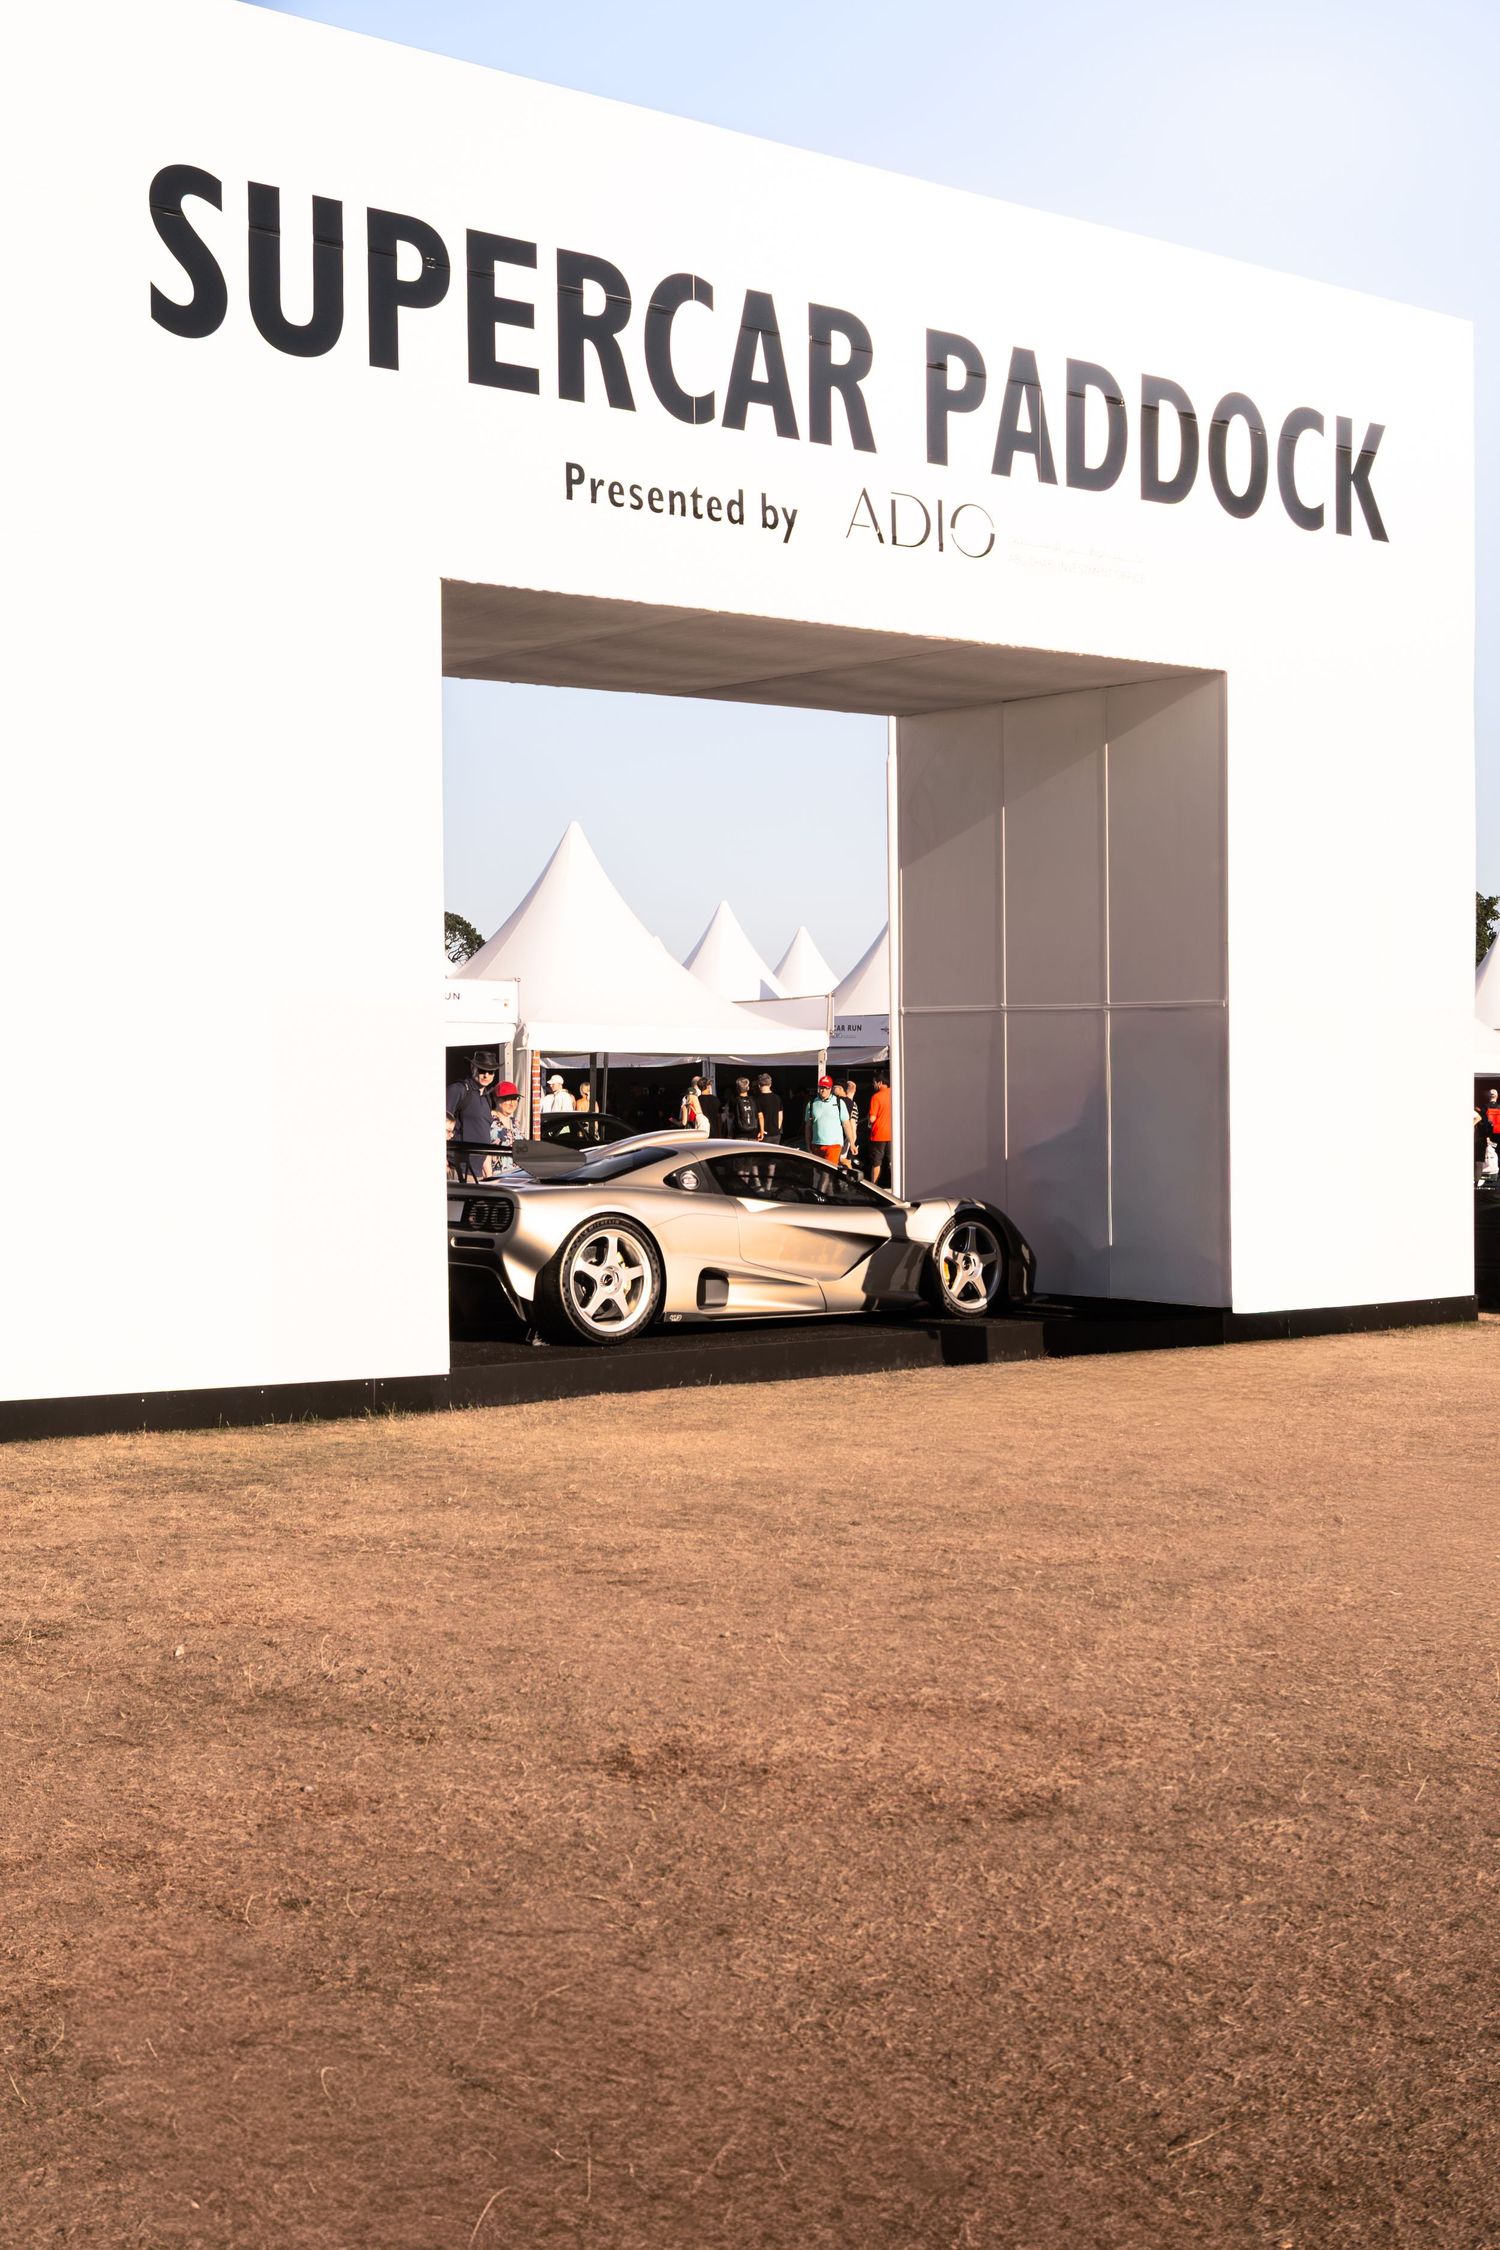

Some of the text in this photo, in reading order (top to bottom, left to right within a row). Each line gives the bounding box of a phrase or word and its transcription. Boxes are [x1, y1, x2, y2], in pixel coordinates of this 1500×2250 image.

[148, 163, 1390, 543] SUPERCAR PADDOCK
[565, 461, 798, 544] Presented by
[844, 487, 996, 559] ADIO
